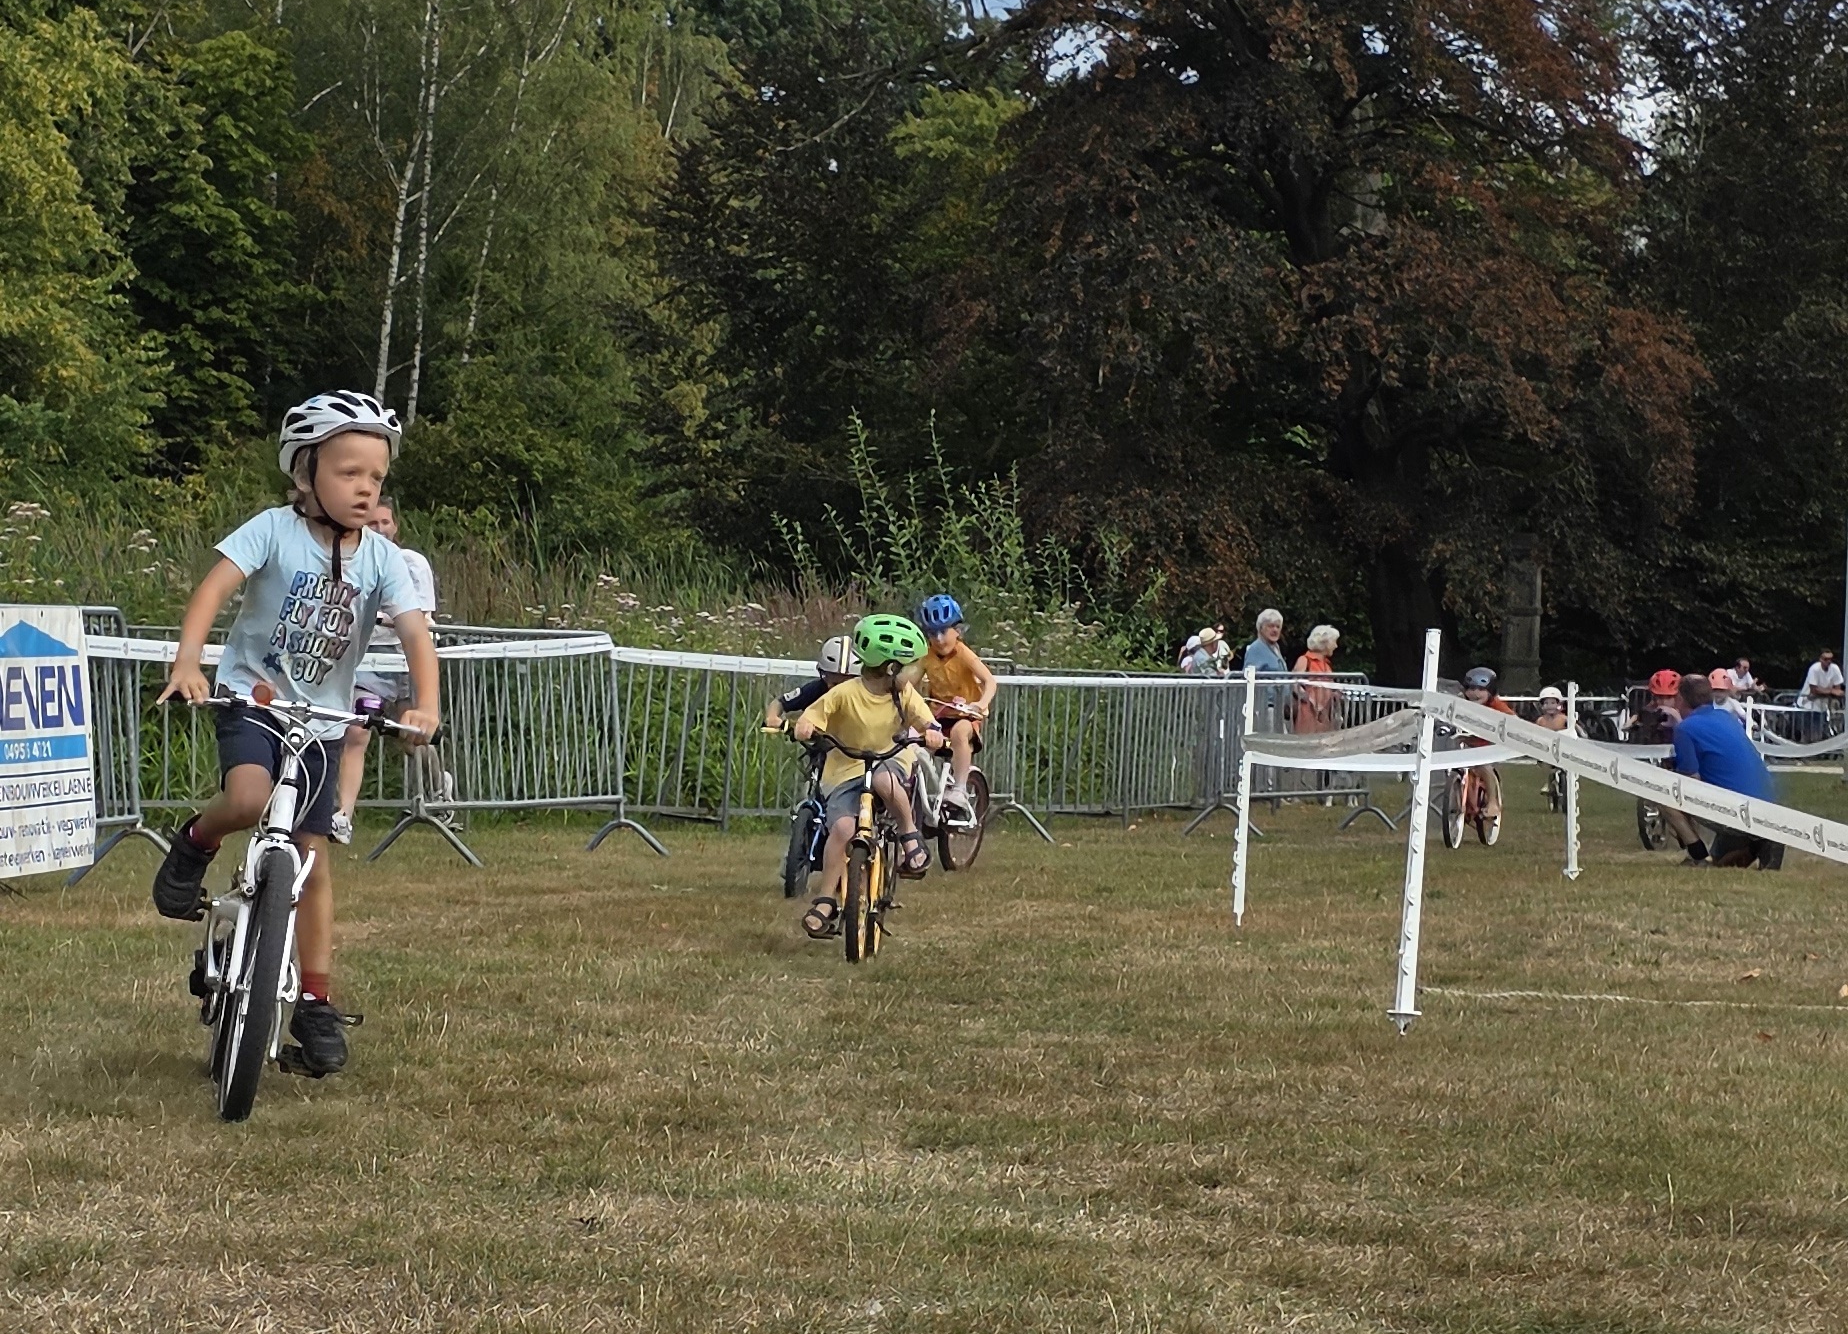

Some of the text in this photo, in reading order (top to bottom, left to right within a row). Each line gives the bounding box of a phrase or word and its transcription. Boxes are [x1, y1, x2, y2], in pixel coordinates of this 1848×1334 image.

[290, 570, 361, 607] PRETTY
[279, 596, 354, 637] FLY FOR
[270, 622, 351, 660] A SHORT
[291, 657, 333, 686] GUY
[0, 664, 85, 731] EVEN
